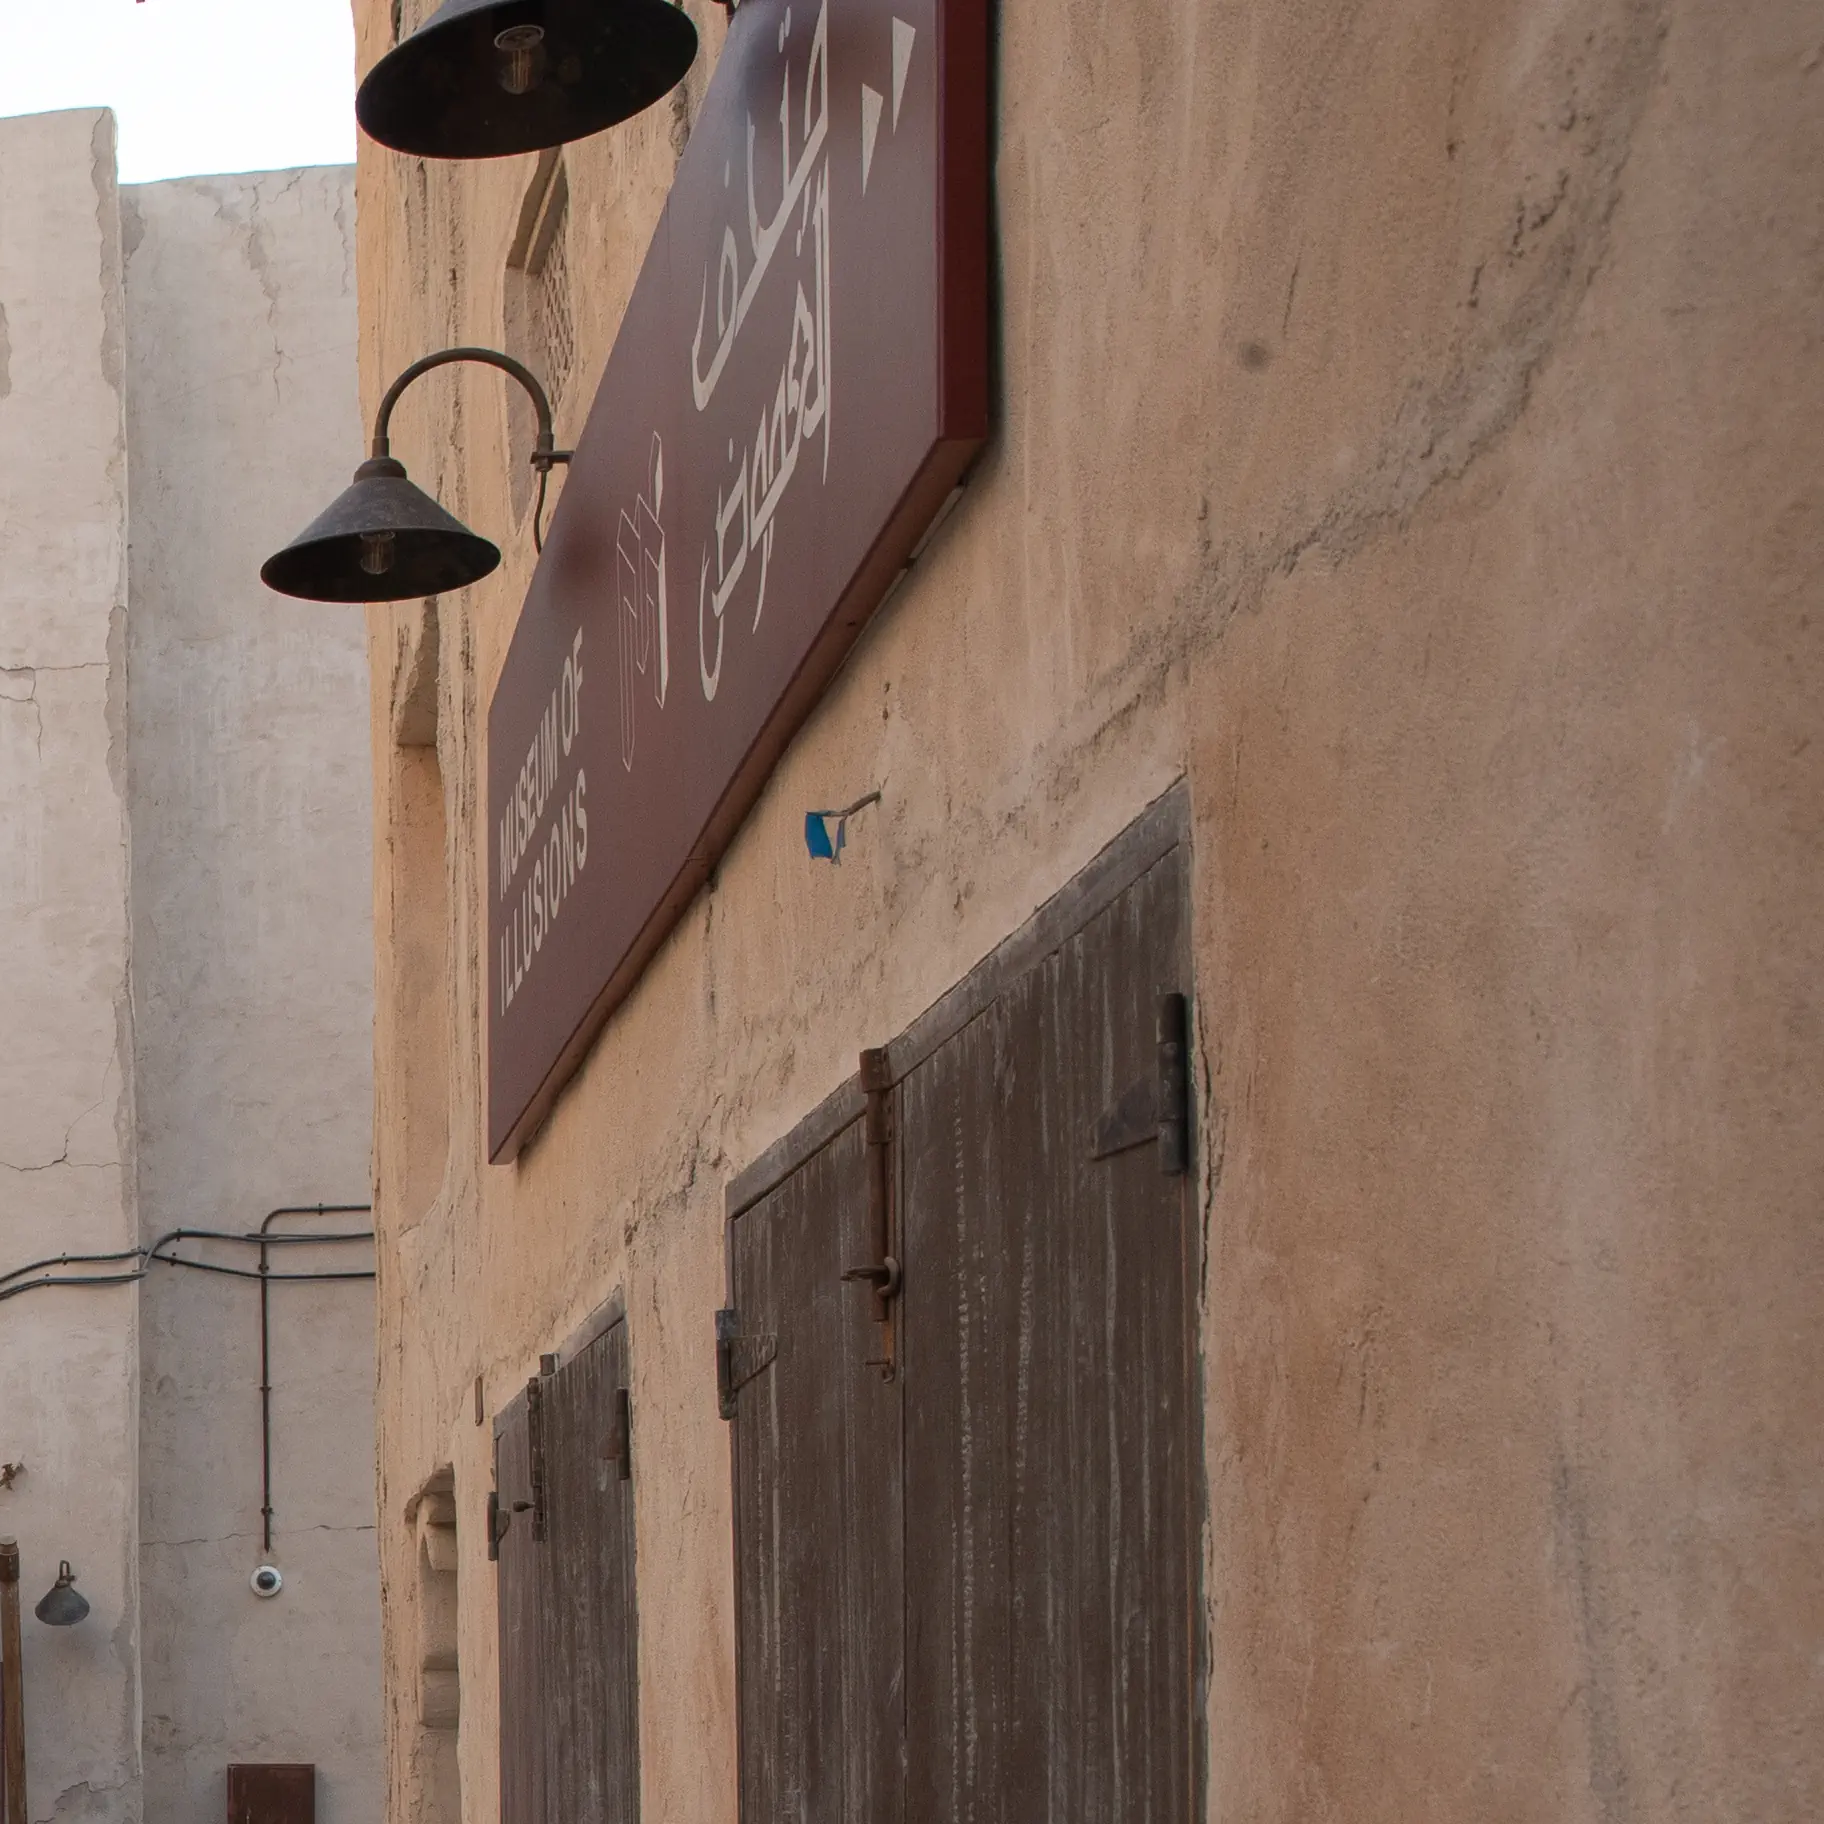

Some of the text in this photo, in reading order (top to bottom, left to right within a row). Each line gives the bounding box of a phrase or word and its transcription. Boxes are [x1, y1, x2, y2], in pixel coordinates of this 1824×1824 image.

[499, 625, 584, 902] MUSEUM OF
[500, 767, 588, 1017] ILLUSIONS
